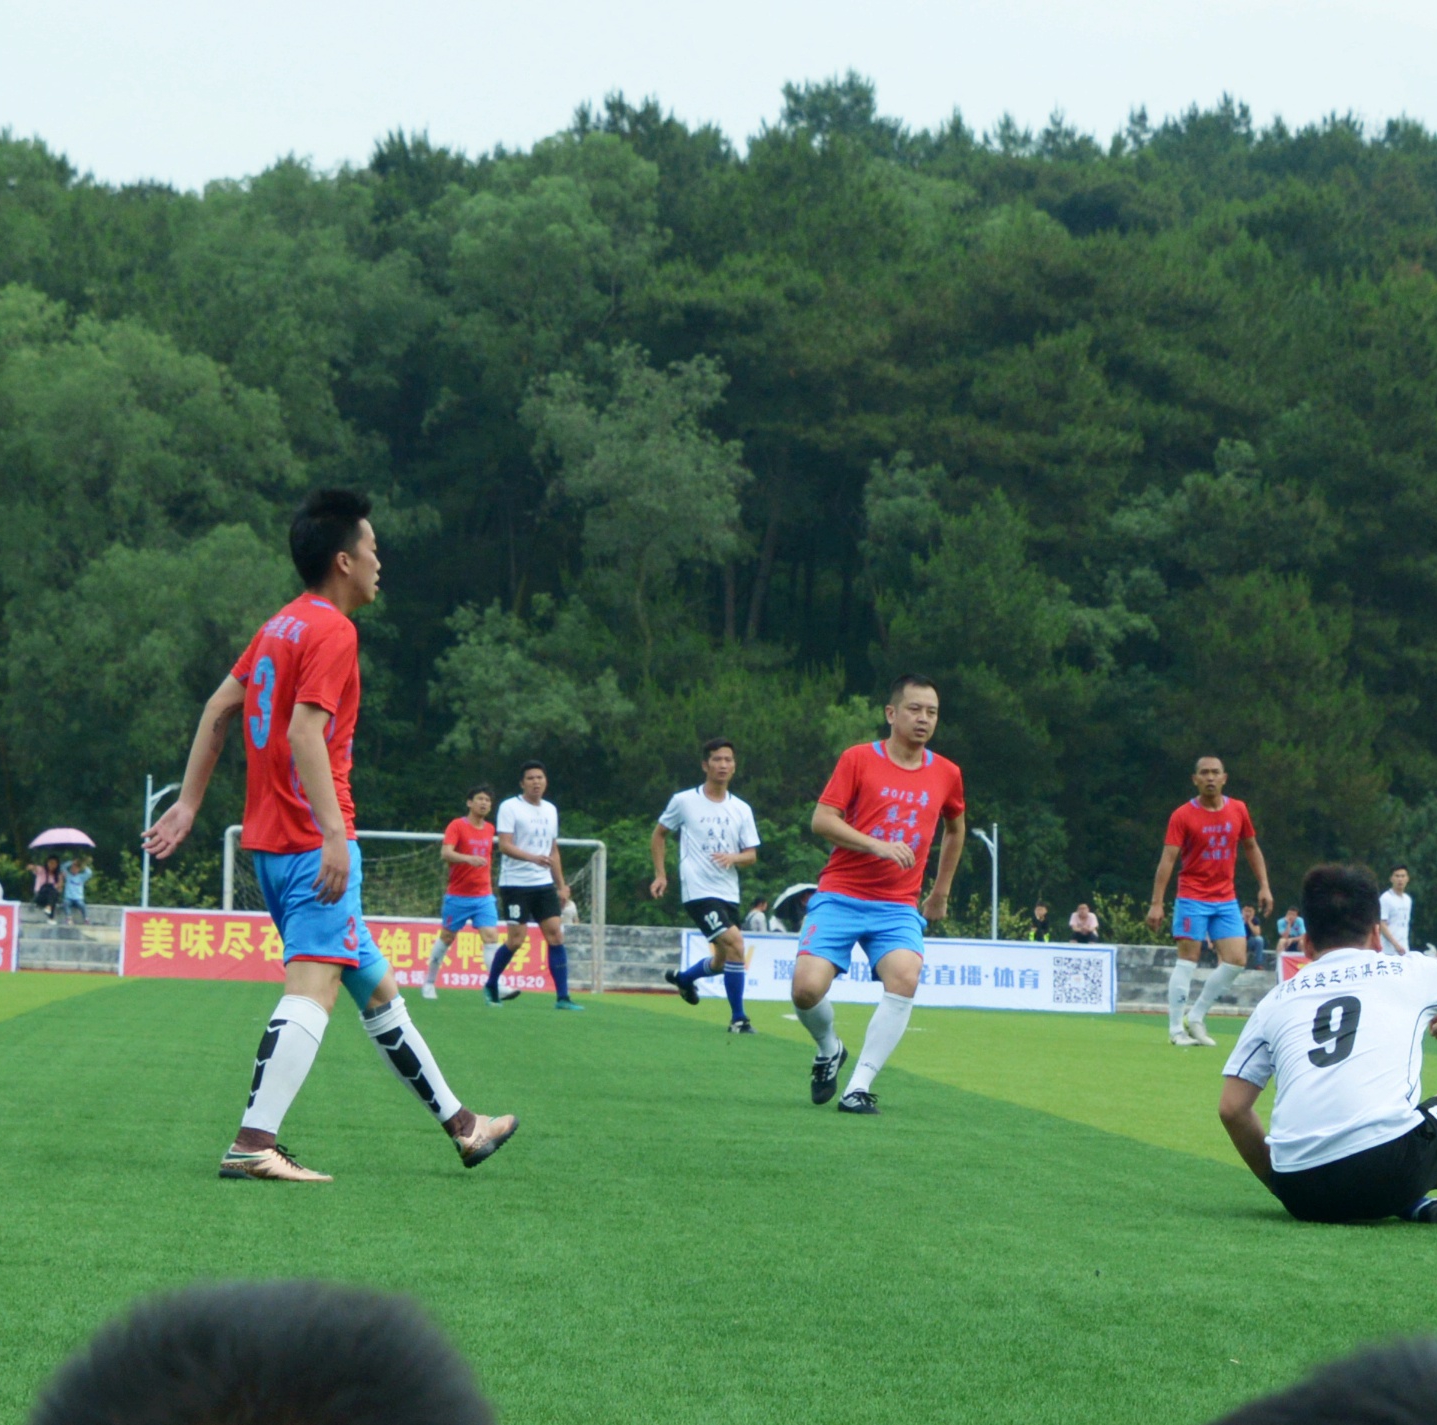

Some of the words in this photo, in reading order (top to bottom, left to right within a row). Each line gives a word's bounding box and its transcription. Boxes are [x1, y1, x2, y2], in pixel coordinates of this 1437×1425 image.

[249, 655, 276, 749] 3
[343, 916, 359, 951] 3
[704, 911, 723, 930] 12
[1308, 996, 1361, 1068] 9
